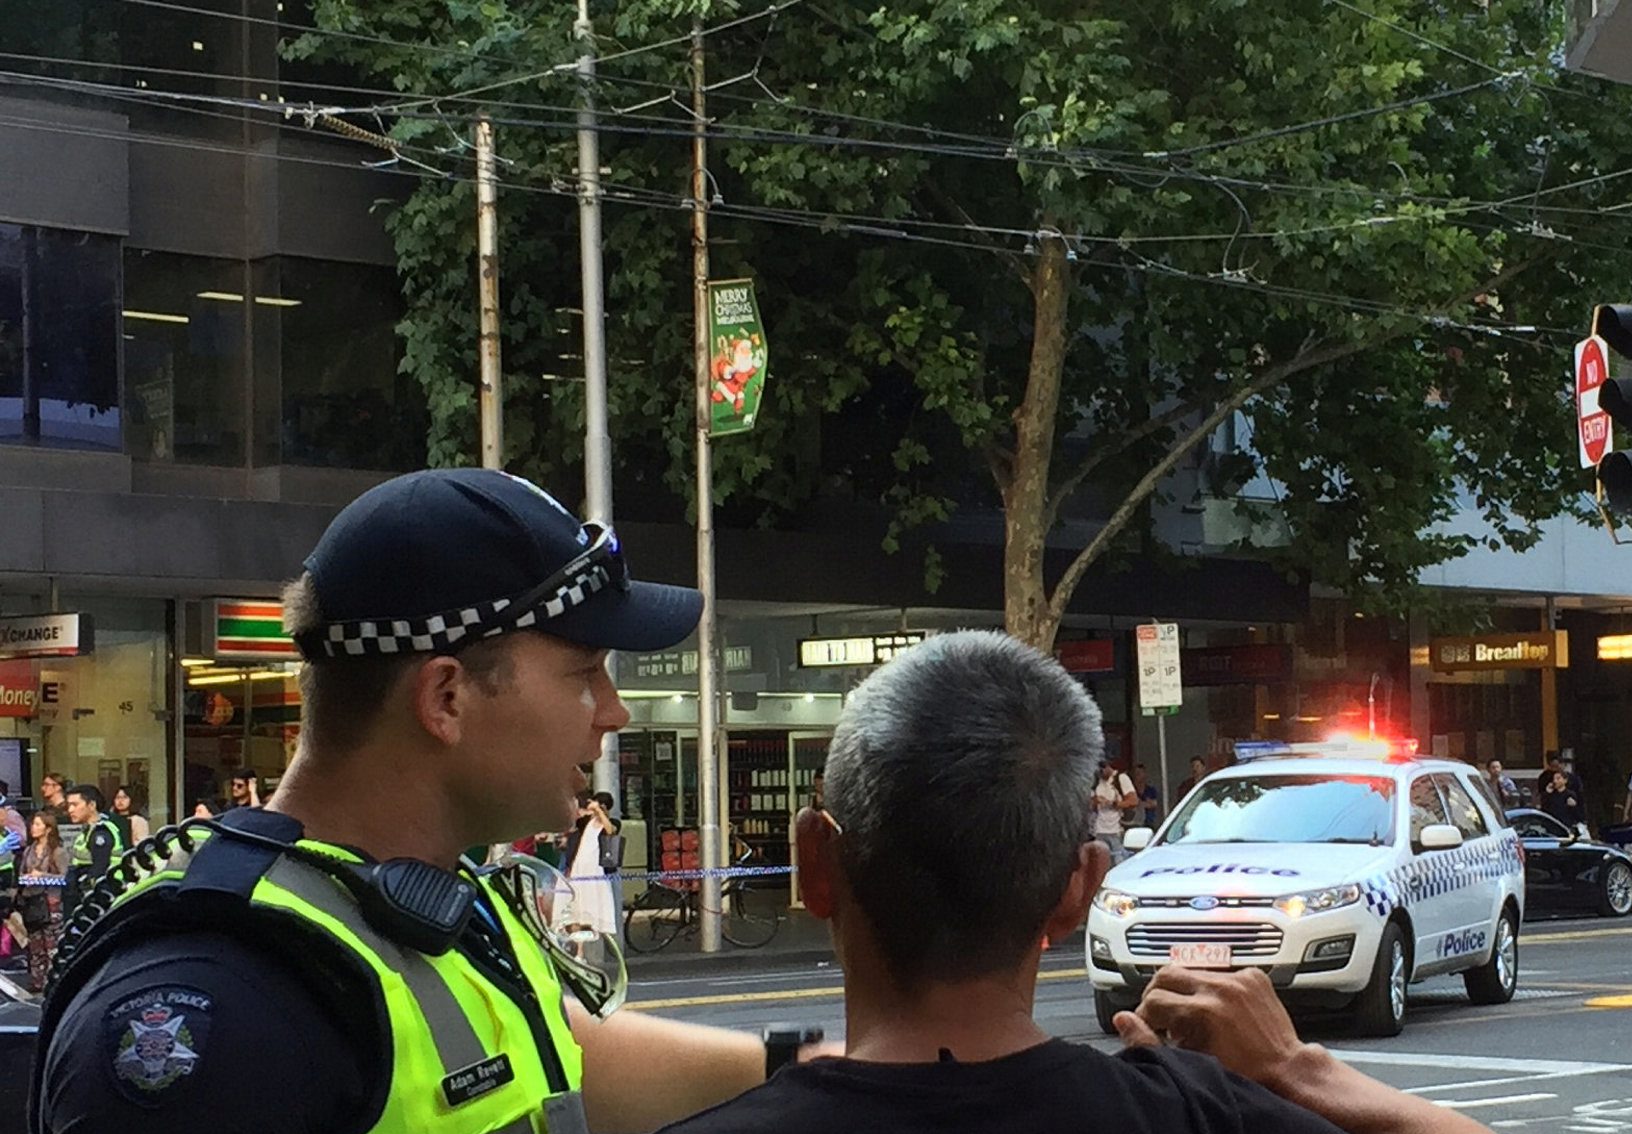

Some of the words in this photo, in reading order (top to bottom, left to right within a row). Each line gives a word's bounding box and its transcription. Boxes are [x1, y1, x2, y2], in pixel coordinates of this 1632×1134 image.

[1475, 641, 1549, 662] Breadtop
[118, 701, 133, 714] 45
[1443, 928, 1486, 958] Police
[166, 991, 210, 1012] POLICE
